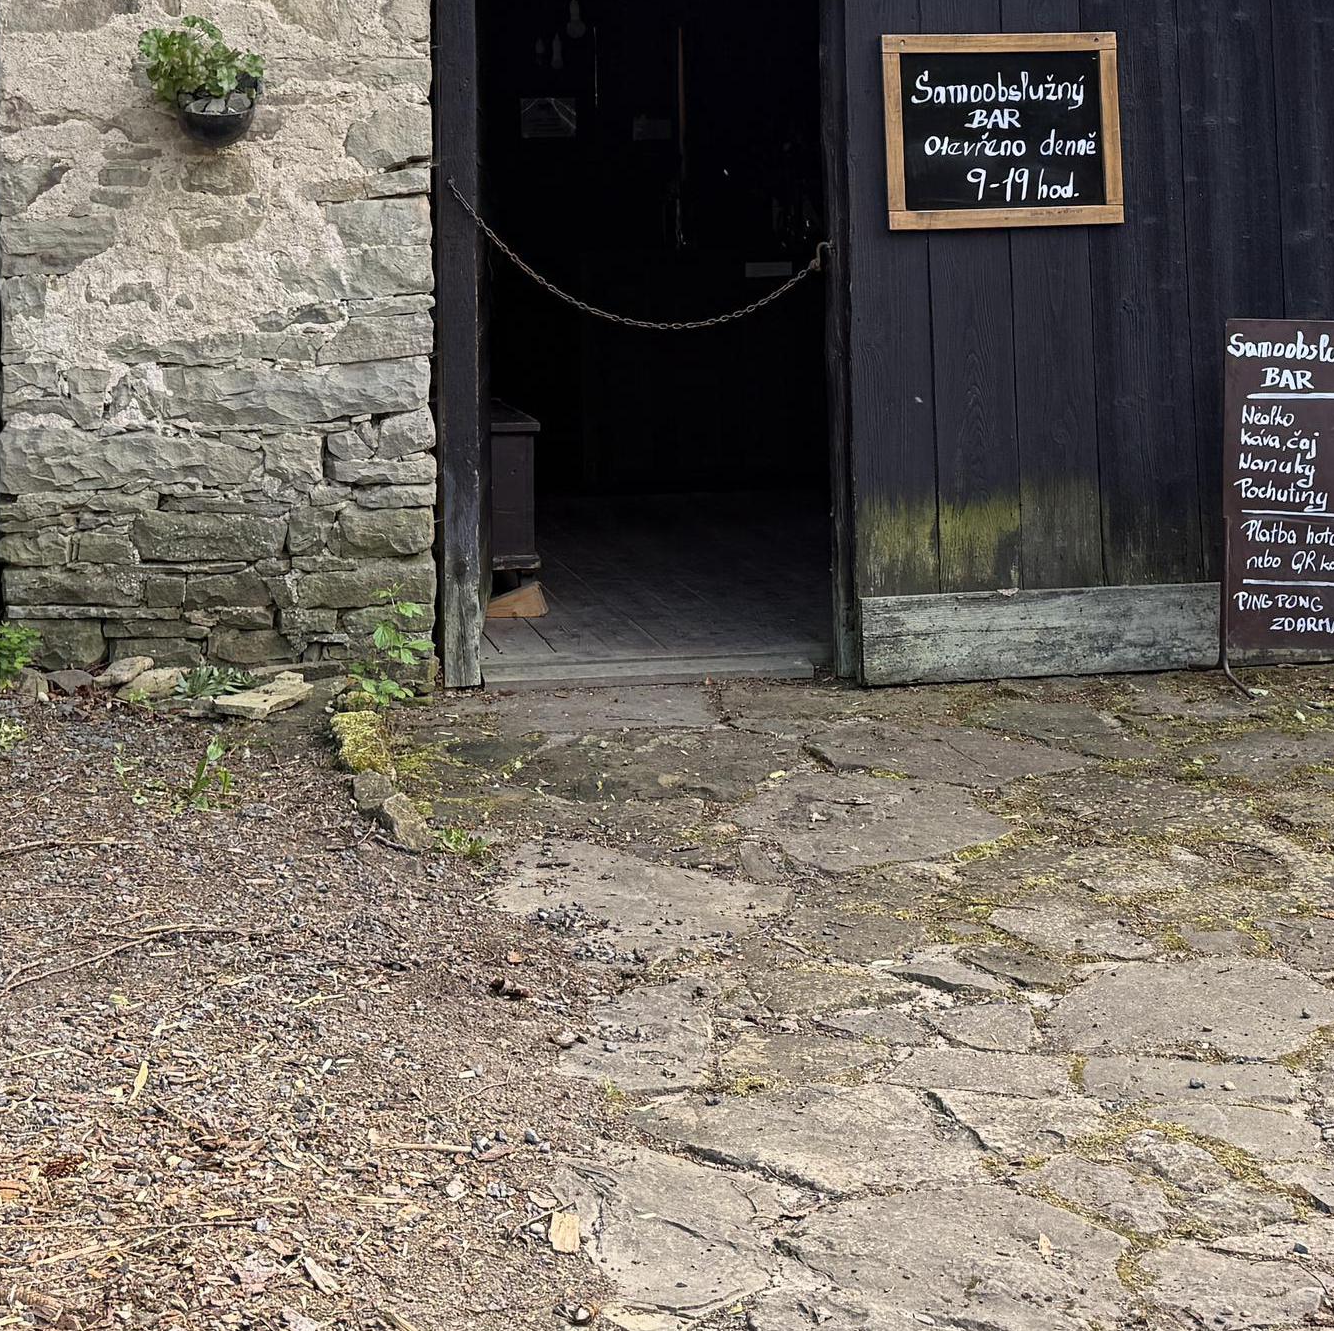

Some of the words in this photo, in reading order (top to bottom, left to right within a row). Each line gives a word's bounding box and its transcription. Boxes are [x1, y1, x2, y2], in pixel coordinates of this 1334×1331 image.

[911, 70, 1085, 110] Samoobslužný
[964, 108, 1021, 129] BAR
[924, 132, 1026, 157] Otevřeno
[1039, 128, 1097, 156] denně
[967, 167, 1029, 201] 9-19
[1037, 169, 1080, 200] hod.
[1260, 367, 1315, 390] BAR
[1238, 452, 1316, 488] Nanuky
[1233, 477, 1328, 511] Pochutiny
[1241, 519, 1297, 544] Platba
[1246, 549, 1282, 569] nebo
[1291, 550, 1316, 574] QR
[1233, 591, 1273, 611] PING
[1275, 594, 1324, 612] PONG
